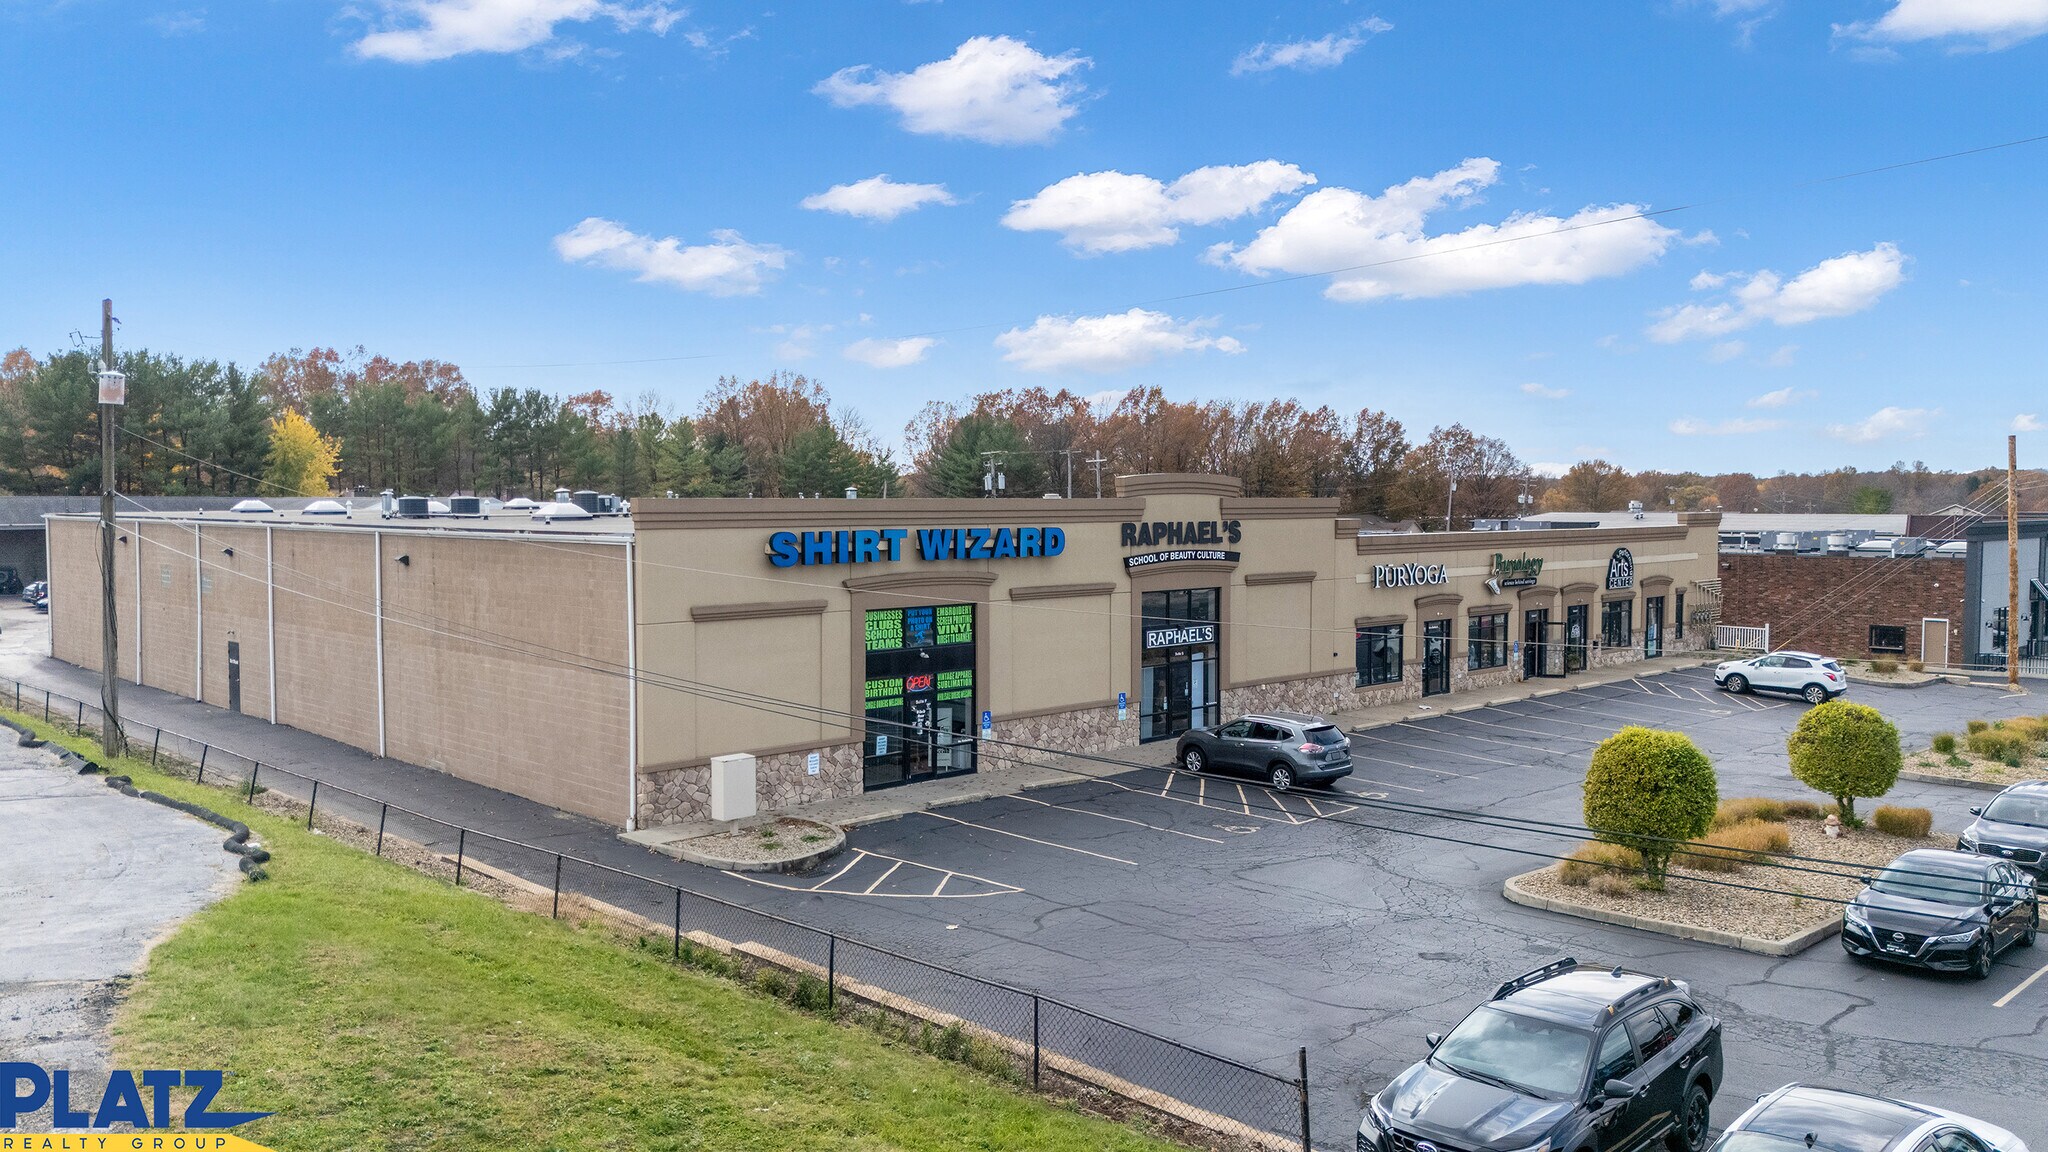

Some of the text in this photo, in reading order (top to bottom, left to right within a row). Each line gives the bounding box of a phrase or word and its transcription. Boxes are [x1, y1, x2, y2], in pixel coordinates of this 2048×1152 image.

[1121, 520, 1242, 547] RAPHAEL'S
[768, 527, 1066, 568] SHIRT WIZARD
[1129, 550, 1226, 567] SCHOOL OF BEAUTY CULTURE
[1610, 558, 1629, 578] Arts
[1609, 576, 1634, 589] CENTER
[865, 609, 903, 621] BUSINESSES
[937, 605, 972, 617] EMBROIDERY
[865, 619, 902, 631] CLUBS
[937, 623, 972, 635] VINYL
[865, 628, 903, 641] SCHOOLS
[1148, 627, 1213, 646] RAPHAEL'S
[865, 638, 902, 651] TEAMS
[865, 678, 903, 690] CUSTOM
[906, 675, 931, 690] OPEN
[865, 686, 903, 698] BIRTHDAY
